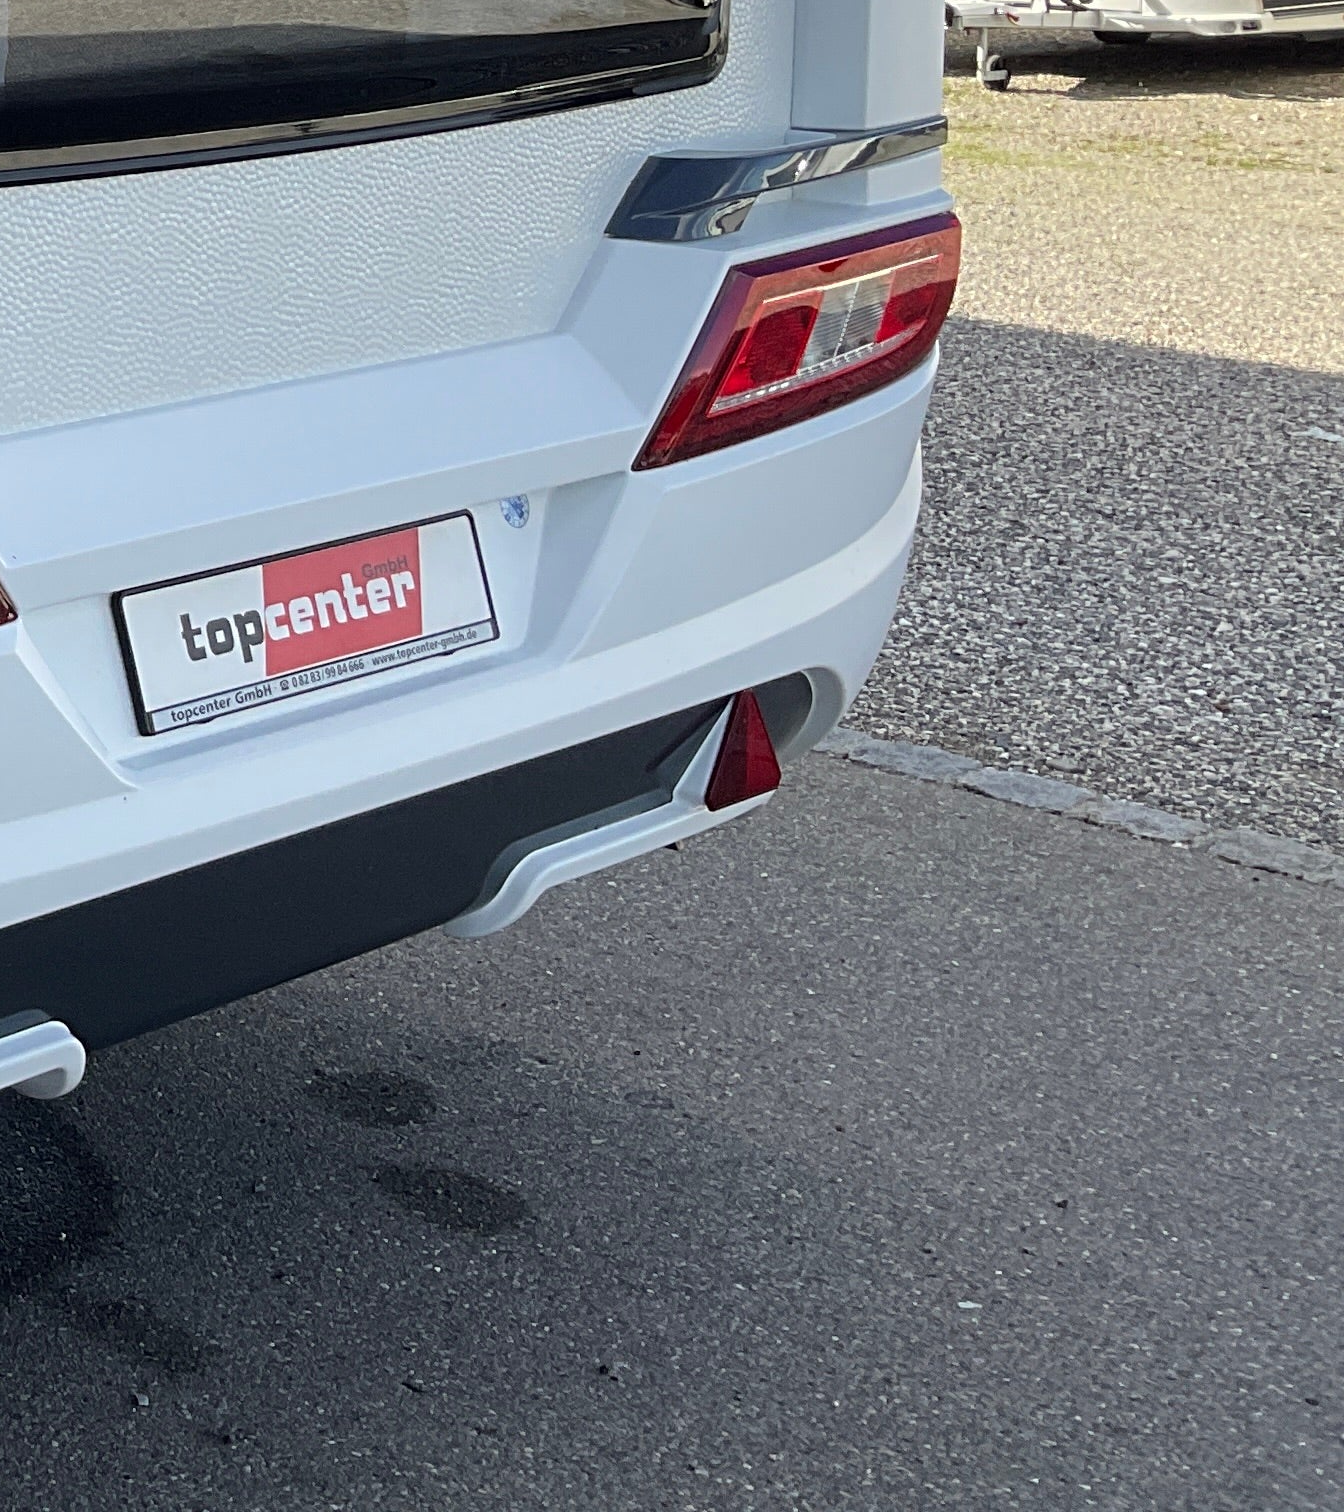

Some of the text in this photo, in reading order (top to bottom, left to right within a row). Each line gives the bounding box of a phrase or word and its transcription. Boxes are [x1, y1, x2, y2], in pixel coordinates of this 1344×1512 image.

[362, 554, 409, 579] GmbH
[179, 570, 416, 664] topcenter
[170, 696, 232, 722] topcenter
[234, 684, 273, 704] GmbH
